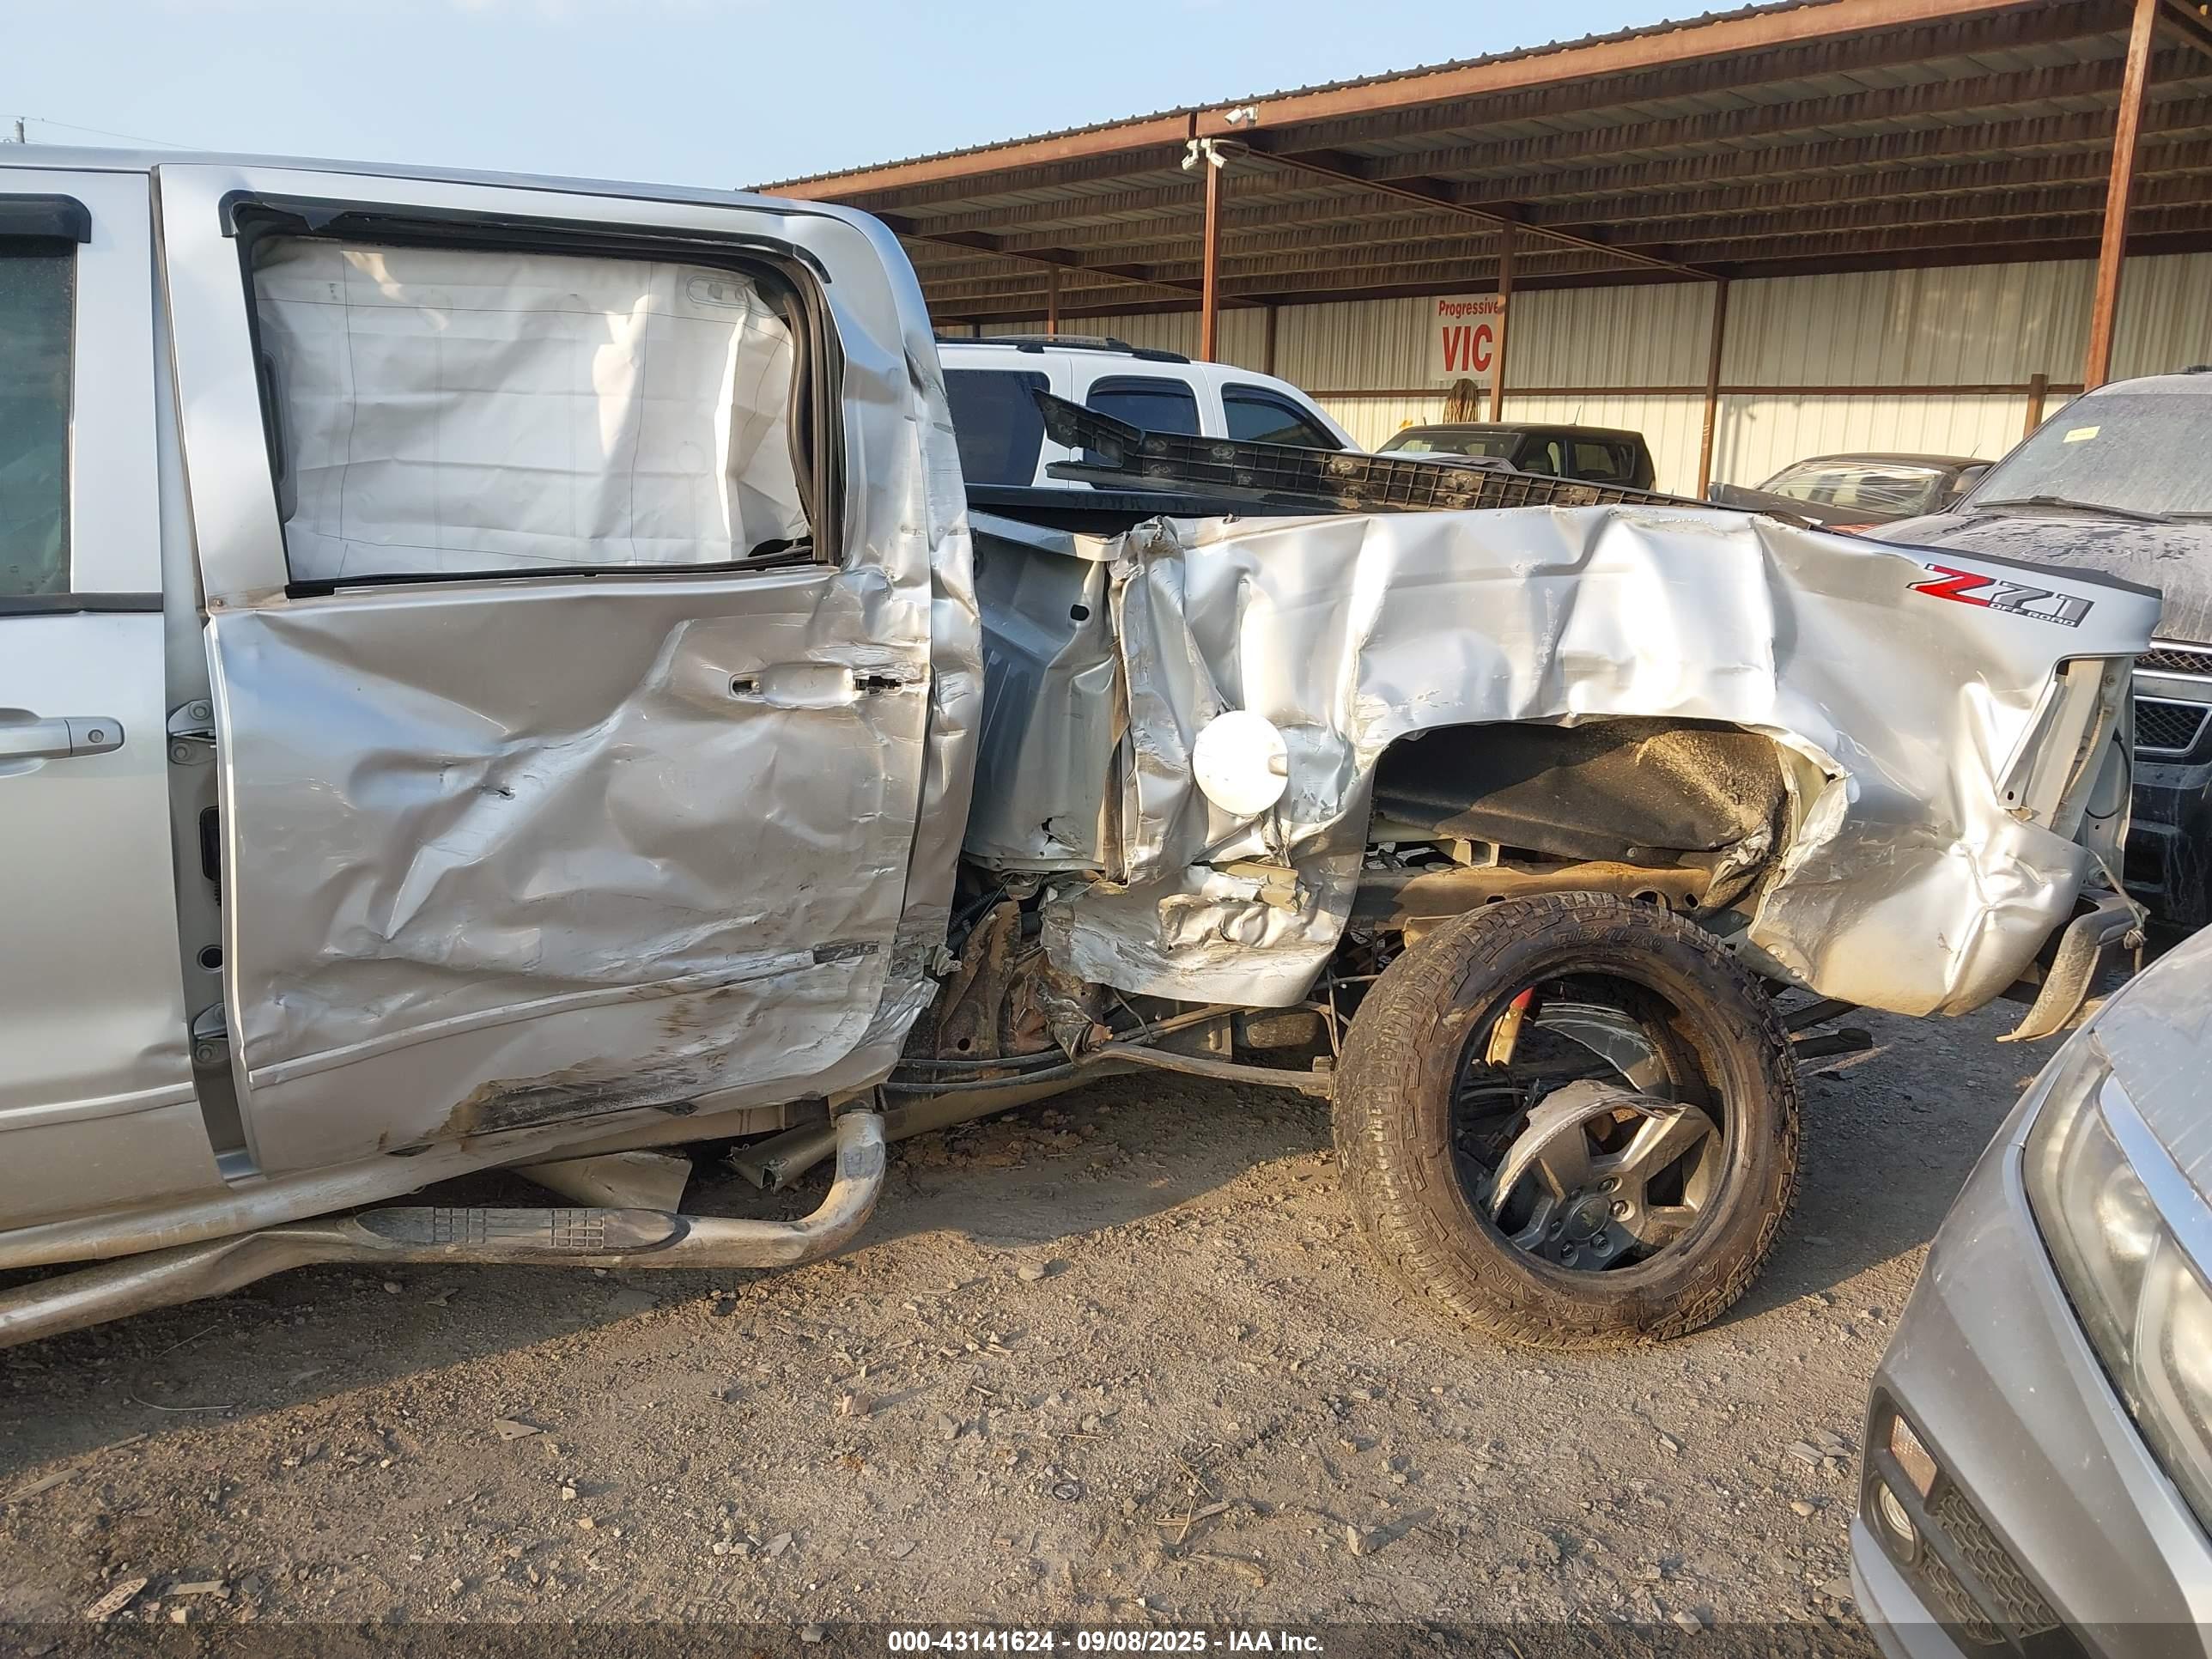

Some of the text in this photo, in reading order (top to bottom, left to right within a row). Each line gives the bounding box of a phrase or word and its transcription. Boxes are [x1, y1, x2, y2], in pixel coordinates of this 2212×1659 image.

[1438, 297, 1498, 319] Progressive
[1442, 323, 1493, 372] VIC
[1906, 563, 2095, 627] Z71
[1990, 603, 2076, 626] OFF ROAD
